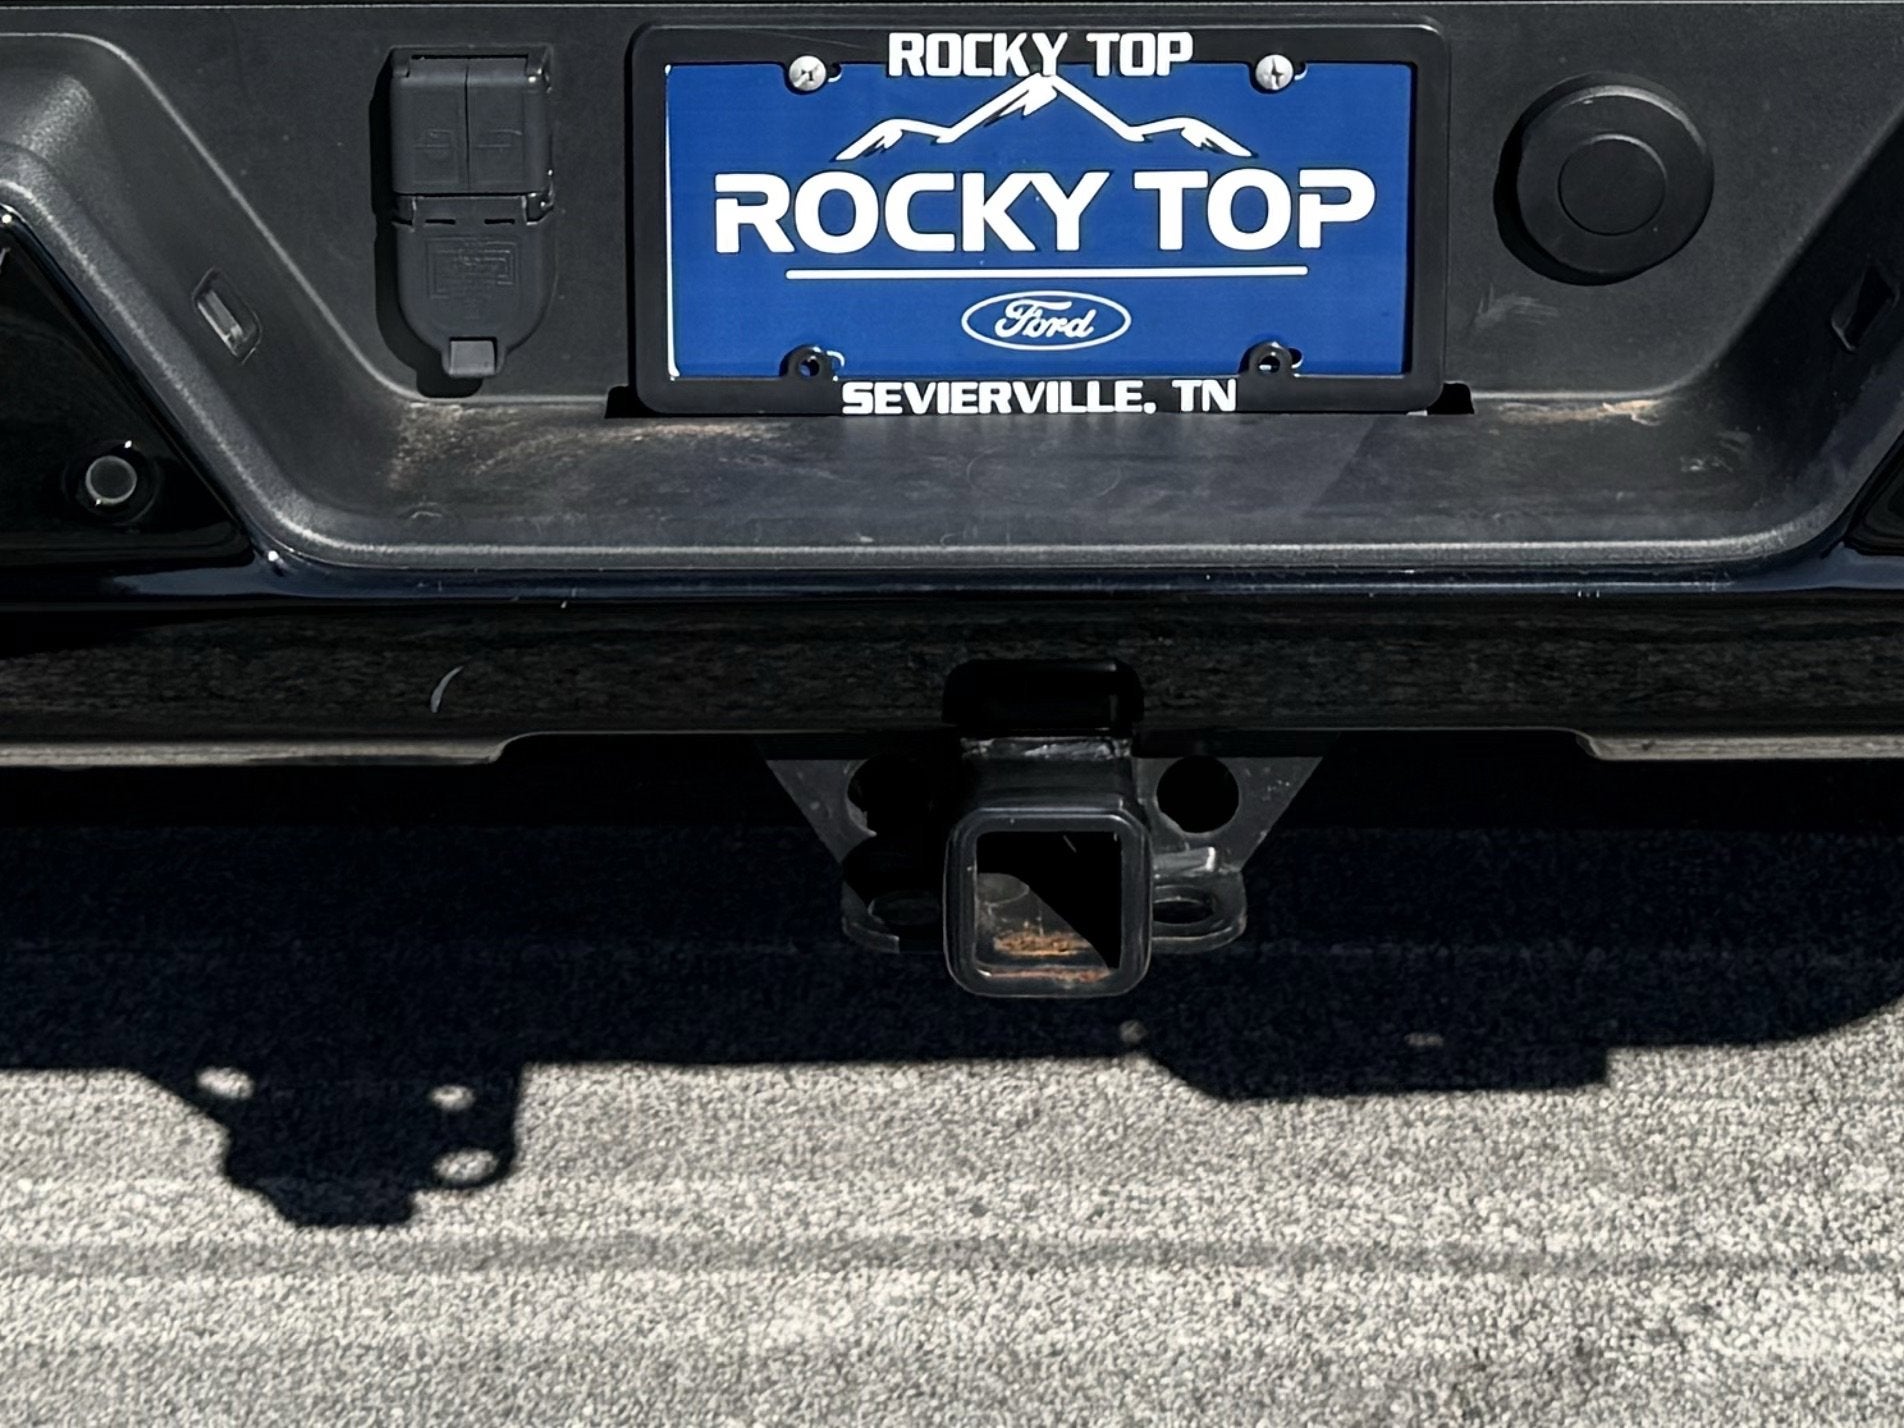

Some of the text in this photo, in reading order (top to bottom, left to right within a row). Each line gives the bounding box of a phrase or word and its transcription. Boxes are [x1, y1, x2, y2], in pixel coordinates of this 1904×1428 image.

[888, 32, 1193, 77] ROCKY TOP
[714, 168, 1376, 253] ROCKY TOP
[994, 300, 1096, 339] Ford
[1172, 379, 1236, 413] TN
